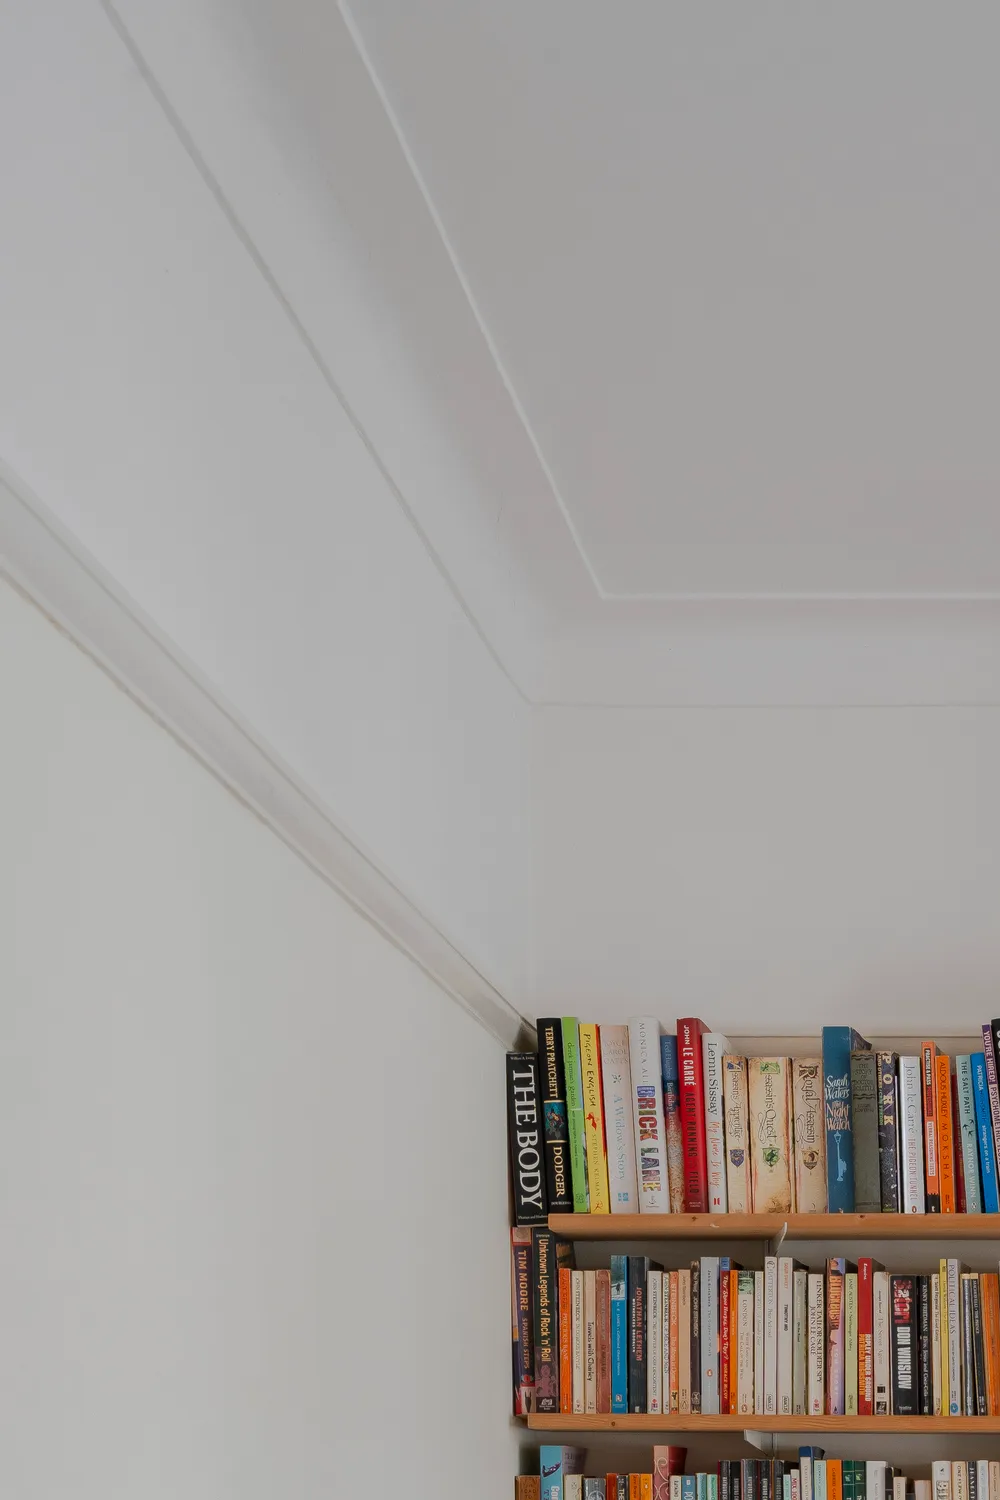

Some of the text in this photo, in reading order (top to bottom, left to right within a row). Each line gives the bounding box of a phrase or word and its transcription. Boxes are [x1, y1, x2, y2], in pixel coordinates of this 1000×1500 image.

[545, 1027, 557, 1098] TERRY PRATCHETT
[707, 1043, 718, 1115] Lemn Sissay
[512, 1064, 543, 1210] THE BODY
[636, 1085, 661, 1192] BRICK LANE
[553, 1147, 565, 1198] DODGER
[518, 1250, 526, 1268] TIM
[539, 1239, 549, 1273] Unknown
[520, 1273, 528, 1311] MOORE
[538, 1276, 550, 1306] Legends
[541, 1318, 550, 1335] Rock
[543, 1348, 551, 1361] Roll
[896, 1327, 911, 1389] DON WINSLOW
